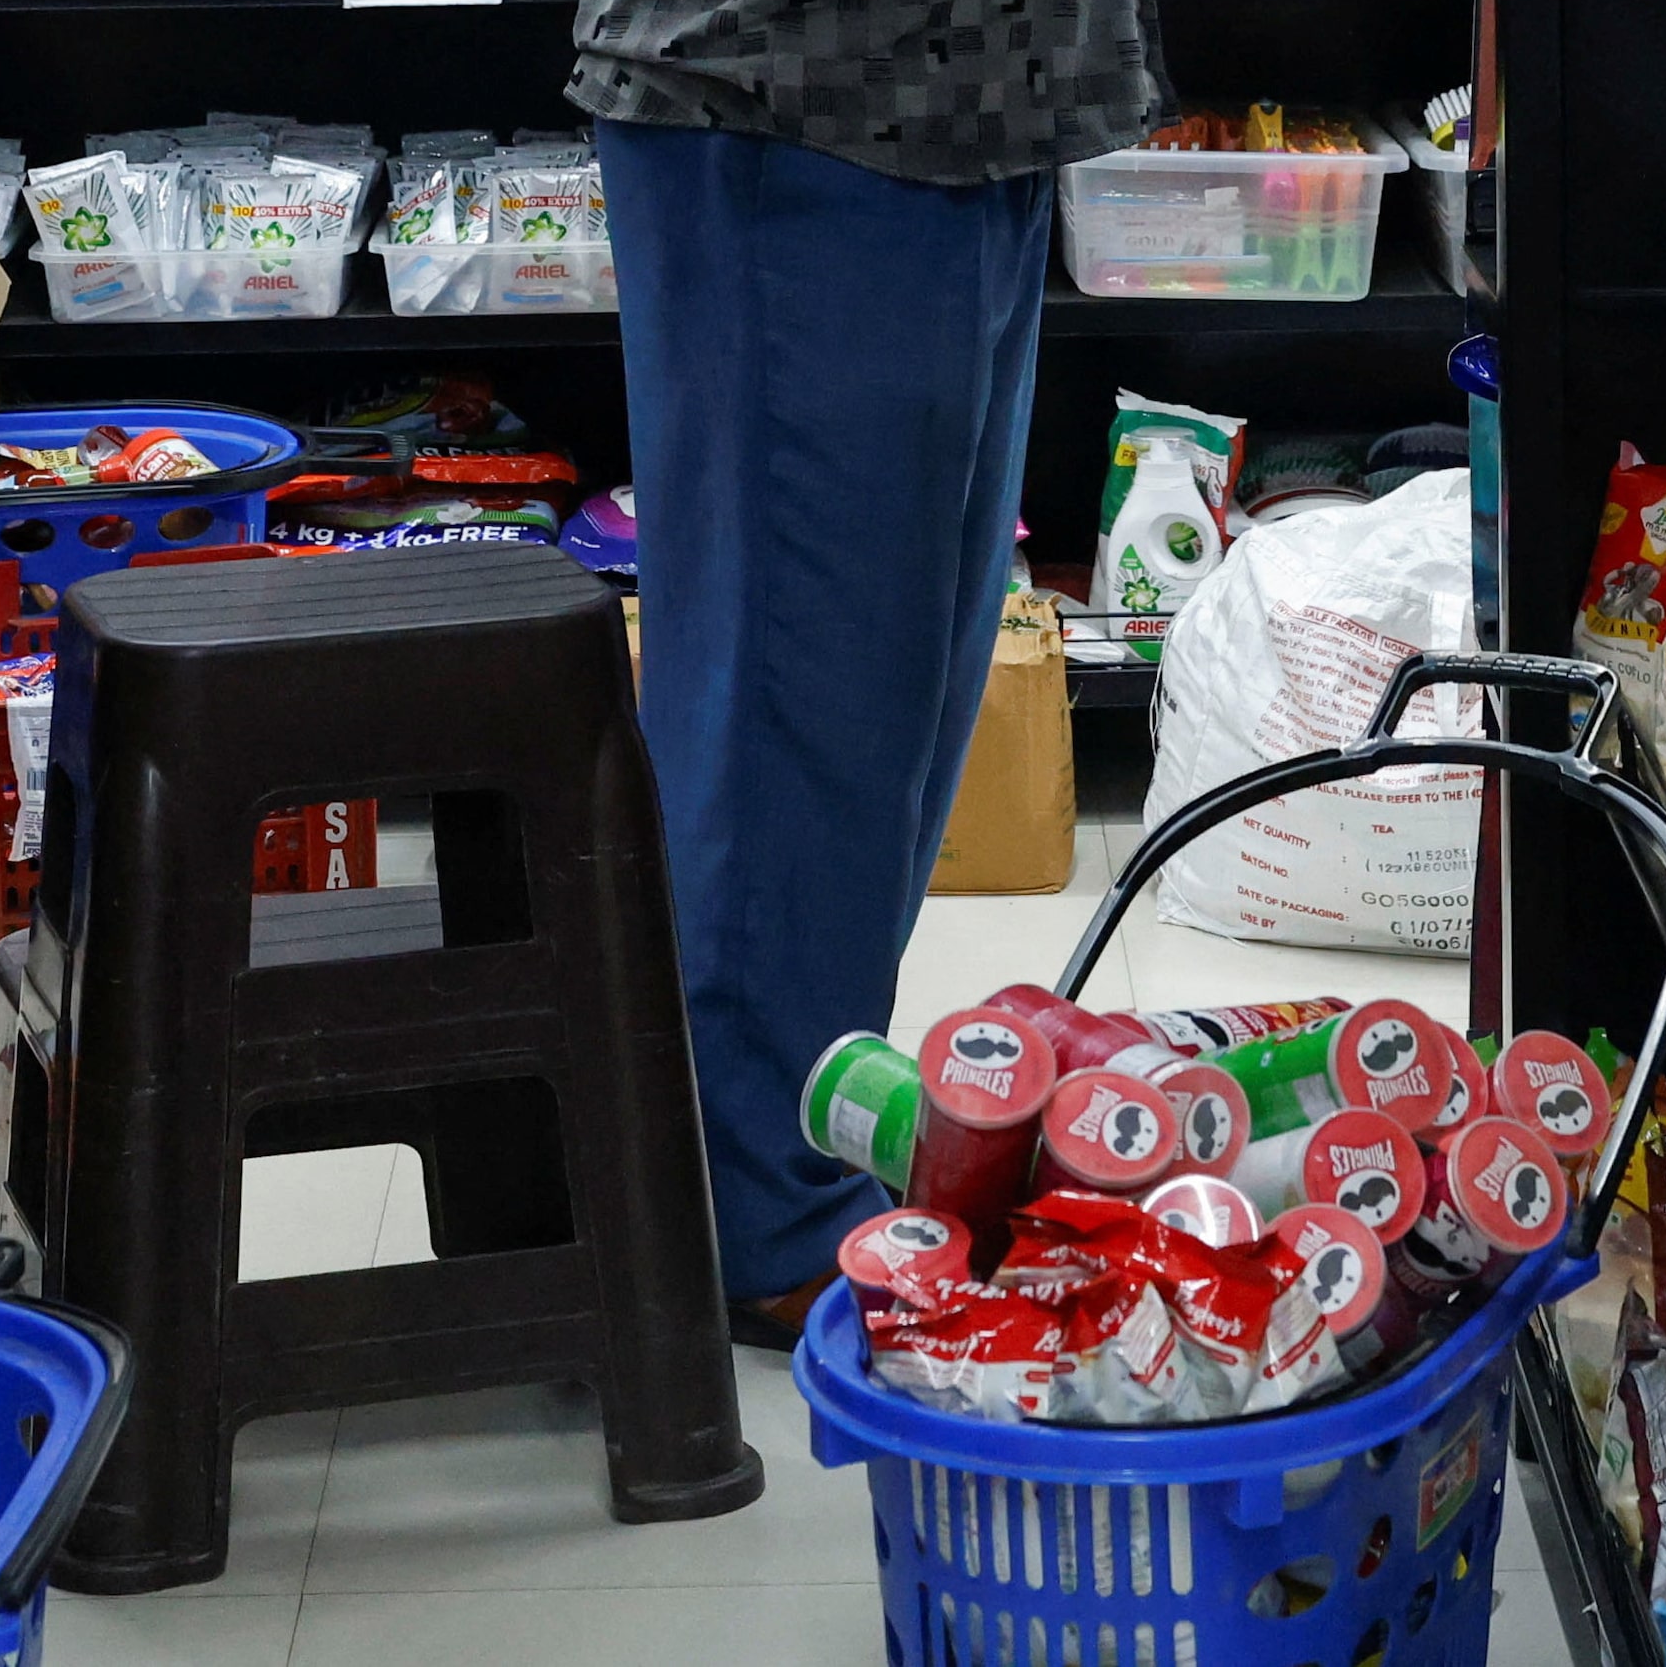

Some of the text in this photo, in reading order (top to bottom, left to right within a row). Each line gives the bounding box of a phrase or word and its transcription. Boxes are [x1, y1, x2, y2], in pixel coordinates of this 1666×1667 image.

[278, 206, 310, 217] EXTRA
[548, 196, 581, 207] EXTRA
[244, 276, 299, 290] ARIEL
[515, 265, 570, 279] ARIEL
[270, 522, 520, 547] 4 kg FREE
[1345, 789, 1383, 803] PLEASE
[1243, 816, 1310, 850] NET QUANTITY
[1372, 824, 1395, 834] TEA
[1241, 851, 1290, 878] BATCH NO.
[1237, 885, 1263, 903] DATE
[1264, 894, 1278, 906] OF
[1240, 911, 1276, 930] USE BY
[940, 1057, 1016, 1100] PRINGLES
[1524, 1059, 1586, 1089] PRINGLES
[1366, 1065, 1431, 1112] PRINGLES
[1329, 1139, 1397, 1177] PRINGLES
[1474, 1137, 1525, 1202] PRINGLES
